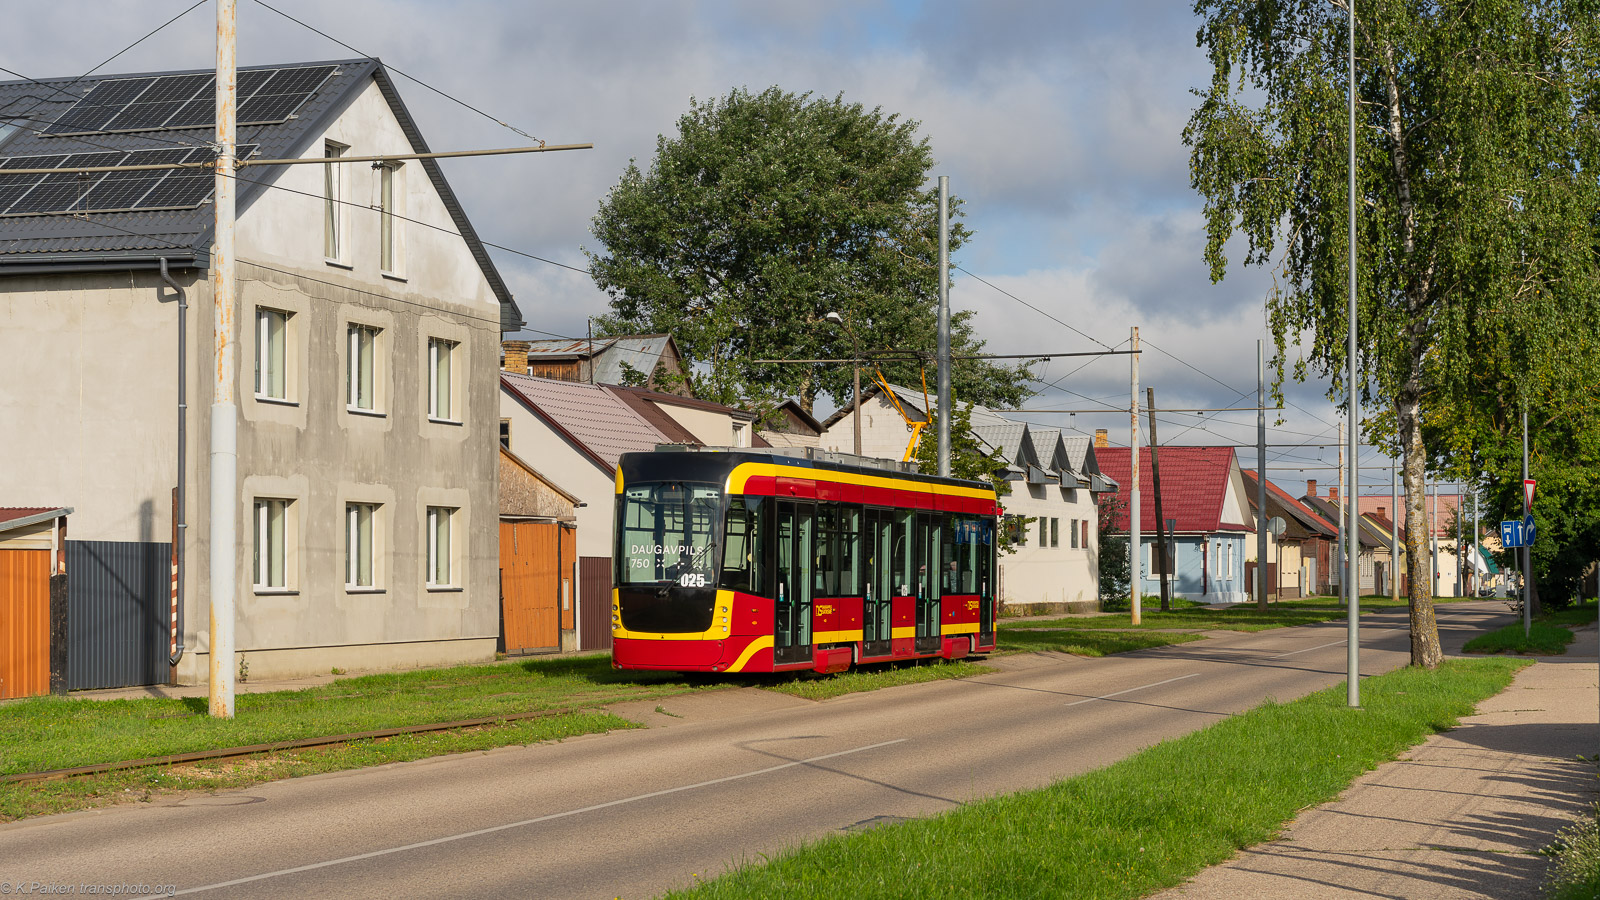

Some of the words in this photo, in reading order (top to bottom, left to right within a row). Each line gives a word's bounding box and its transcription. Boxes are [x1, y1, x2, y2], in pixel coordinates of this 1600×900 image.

[631, 544, 704, 556] DAUGAVPILS
[631, 558, 650, 569] 750
[680, 573, 705, 588] 025
